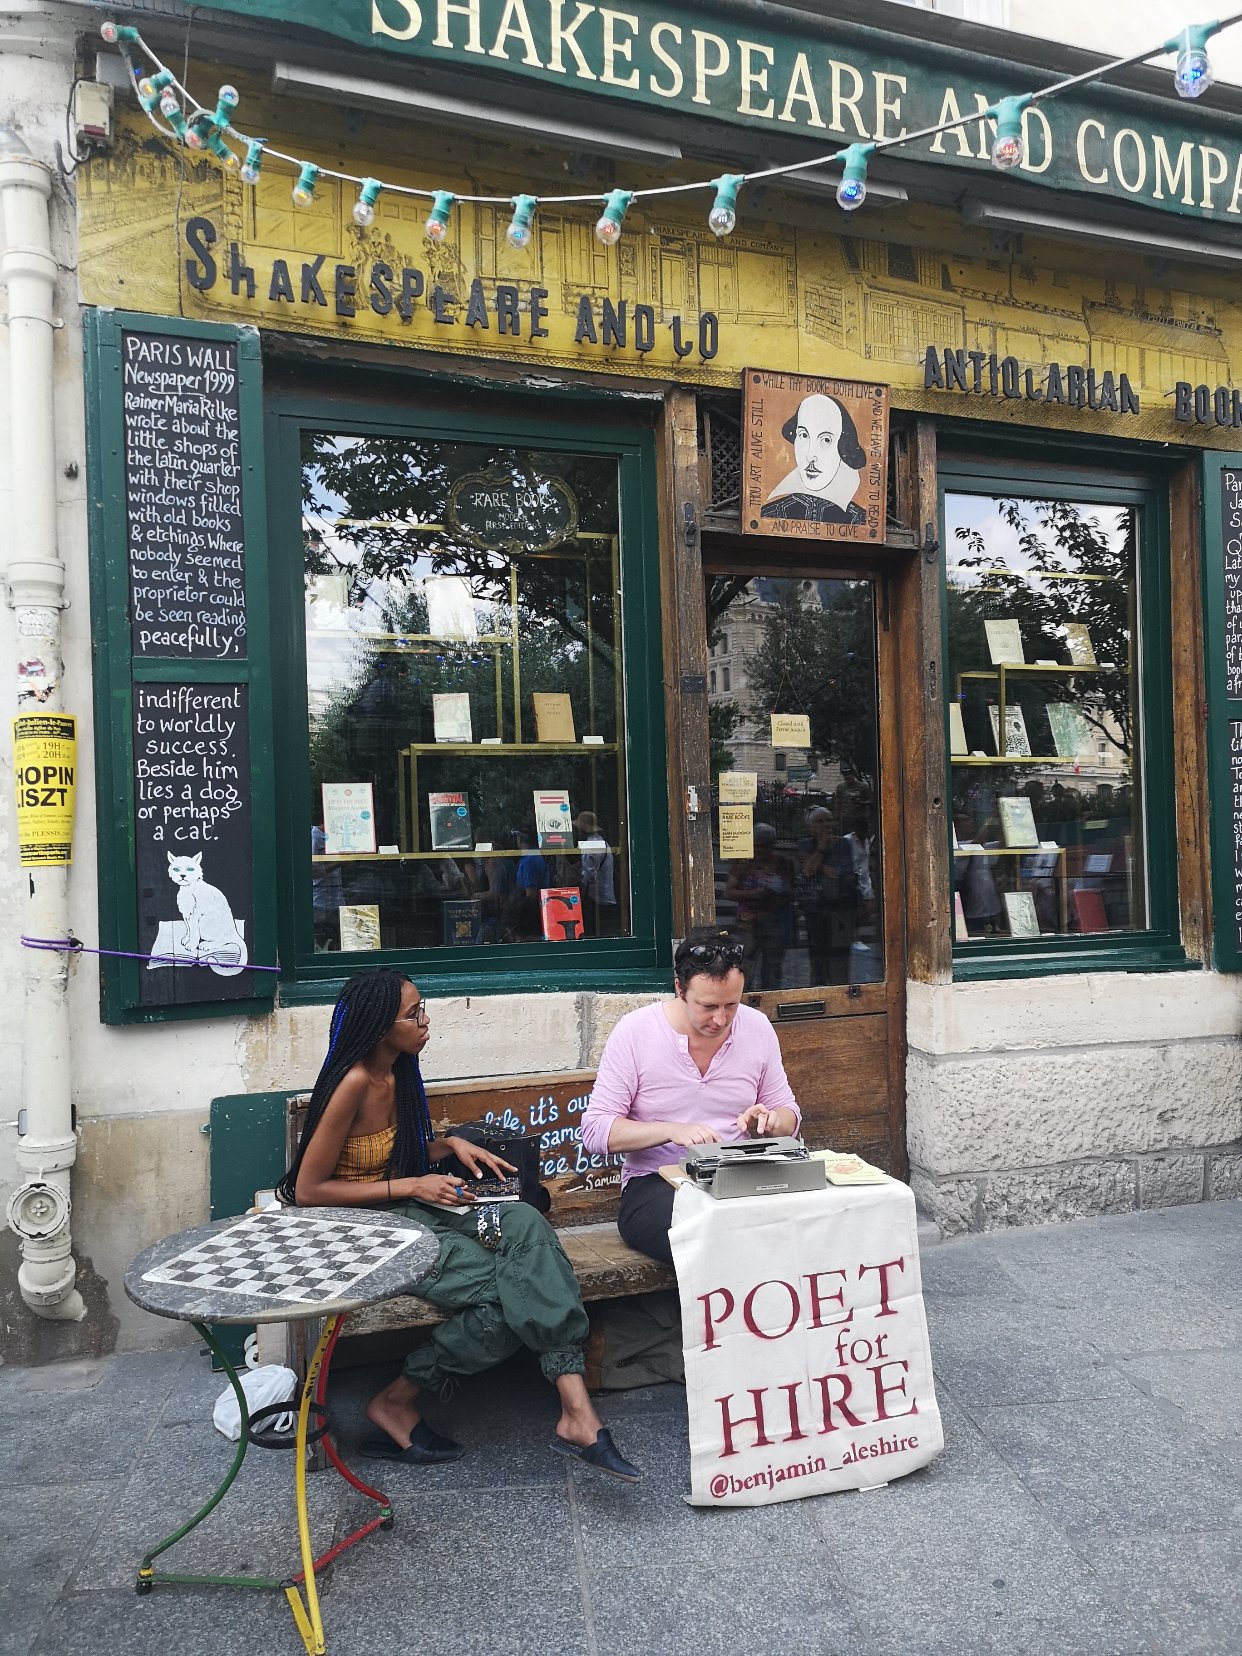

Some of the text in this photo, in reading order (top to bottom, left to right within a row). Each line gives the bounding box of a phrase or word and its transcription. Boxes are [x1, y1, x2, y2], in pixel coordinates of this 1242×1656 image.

[574, 295, 655, 353] AND
[126, 336, 236, 372] PARIS WALL
[124, 362, 235, 395] Newspaper 1999
[762, 372, 874, 400] WHILE THY BOOKE DOTH LIVE
[124, 391, 238, 422] Rainer Maria Rilke
[125, 412, 239, 442] wrote about the
[126, 429, 238, 466] little shops of
[749, 398, 764, 507] THOU ART ALIVE STILL
[127, 449, 241, 480] the latin quarter
[867, 399, 883, 528] AND WE HAVE WITS TO READ
[128, 467, 241, 502] with their shop
[128, 488, 242, 516] windows filled
[474, 492, 552, 508] RARE BOOKS
[128, 505, 231, 532] with old books
[771, 521, 858, 539] AND PRAISE TO GIVE
[131, 524, 144, 543] &
[207, 532, 244, 553] Where
[130, 544, 244, 571] nobody seemed
[132, 563, 242, 589] to enter & the
[133, 584, 246, 608] proprietor could
[135, 603, 246, 637] be seen reading
[139, 623, 239, 658] peacefully,
[139, 686, 241, 714] indifferent
[137, 712, 236, 741] to worldly
[145, 739, 236, 758] success.
[136, 756, 239, 780] Beside him
[18, 788, 67, 808] ISZT
[139, 779, 243, 811] lies a dog
[138, 800, 231, 825] or perhaps
[153, 820, 219, 841] a cat.
[529, 1096, 559, 1126] it's
[697, 1256, 905, 1352] POET
[834, 1328, 889, 1367] for
[714, 1360, 919, 1458] HIRE
[709, 1433, 919, 1499] @benjamin_aleshire
